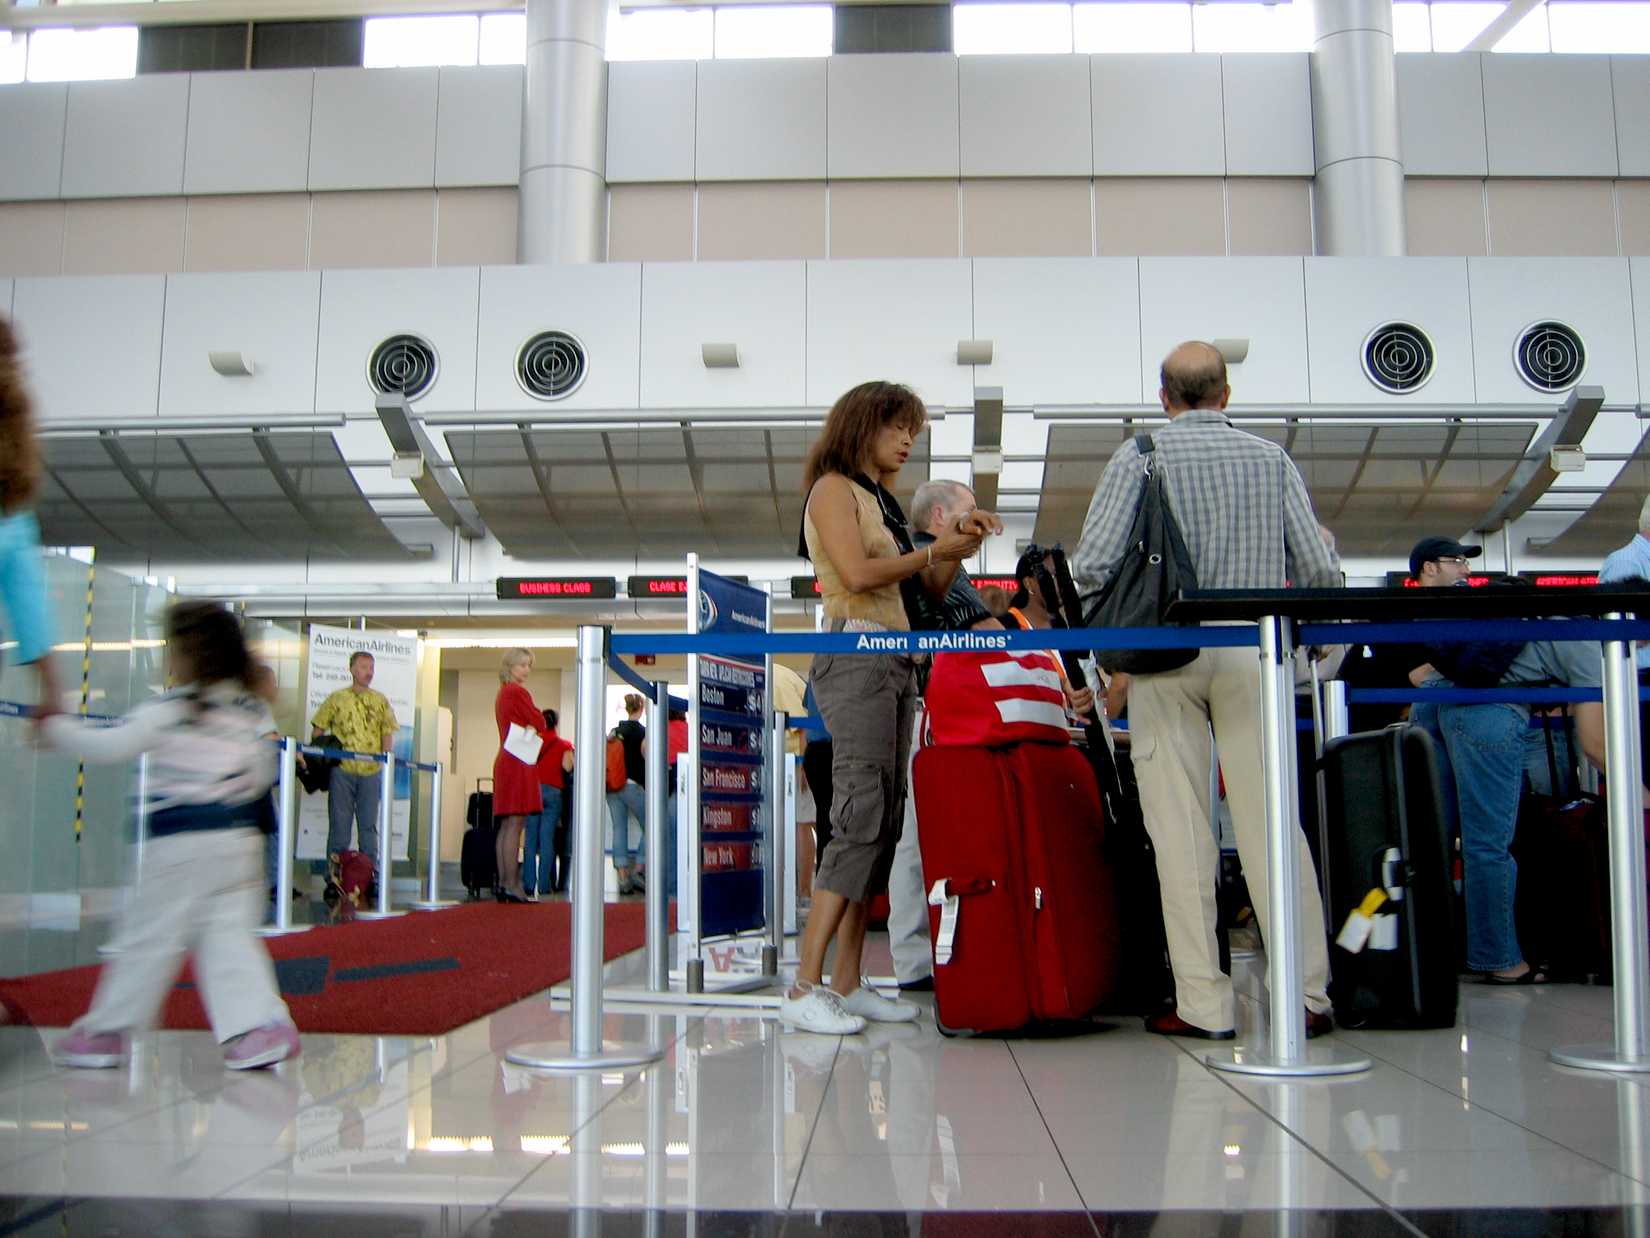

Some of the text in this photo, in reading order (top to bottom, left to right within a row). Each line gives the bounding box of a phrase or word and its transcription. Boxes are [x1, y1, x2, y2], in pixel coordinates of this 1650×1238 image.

[315, 633, 412, 656] AmericanAirlines
[701, 683, 725, 705] Boston
[702, 724, 715, 744] San
[716, 727, 733, 746] Juan
[702, 767, 715, 787] San
[715, 768, 746, 789] Francisco
[702, 807, 732, 829] Kingston
[703, 847, 717, 865] New
[718, 847, 735, 867] York
